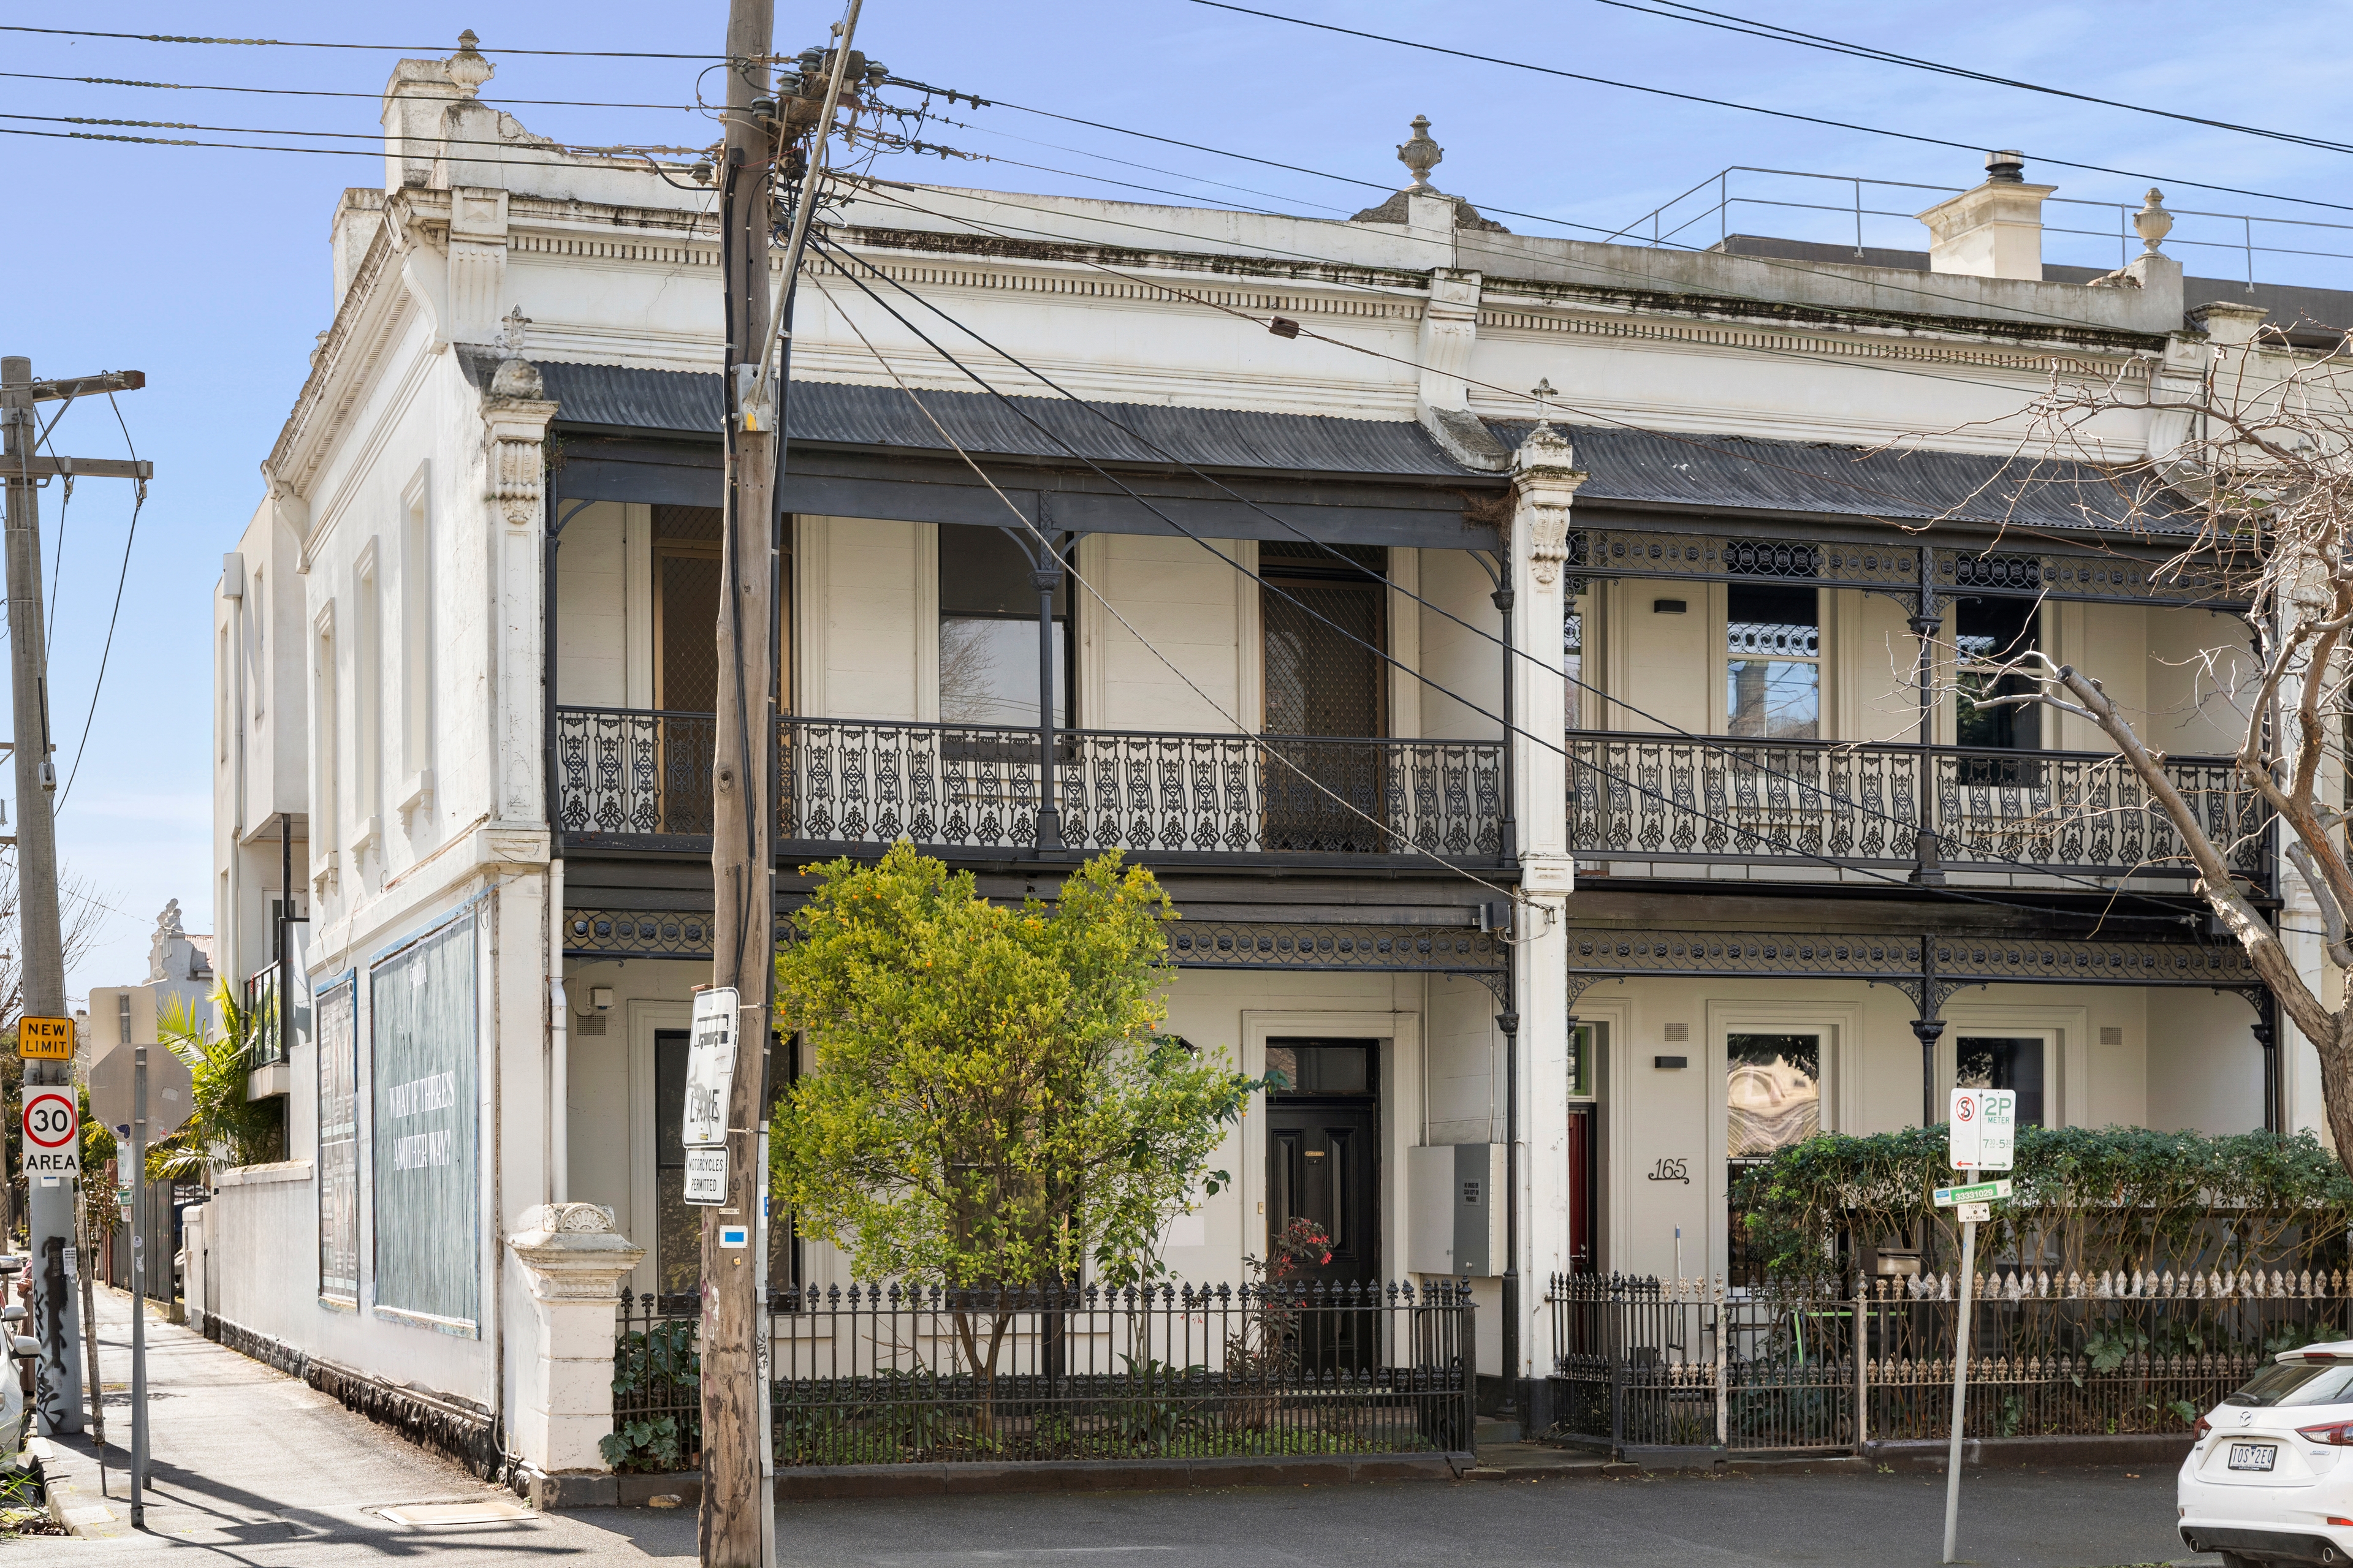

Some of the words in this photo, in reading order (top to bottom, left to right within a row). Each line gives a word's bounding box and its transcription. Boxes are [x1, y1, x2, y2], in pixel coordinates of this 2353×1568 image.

[409, 961, 427, 990] PRADA
[28, 1023, 65, 1036] NEW
[26, 1040, 66, 1053] LIMIT
[389, 1083, 409, 1119] WHAT
[411, 1080, 419, 1114] IF
[420, 1070, 454, 1112] THERE'S
[1985, 1097, 2012, 1116] 2P
[34, 1110, 67, 1132] 30
[393, 1134, 428, 1170] ANOTHER
[428, 1129, 450, 1166] WAY?
[26, 1154, 77, 1170] AREA
[688, 1159, 723, 1172] MOTORCYCLES
[1656, 1158, 1688, 1179] 165
[691, 1178, 717, 1192] PERMITTED
[1955, 1189, 1993, 1201] 33331029
[2255, 1449, 2273, 1464] 2EQ
